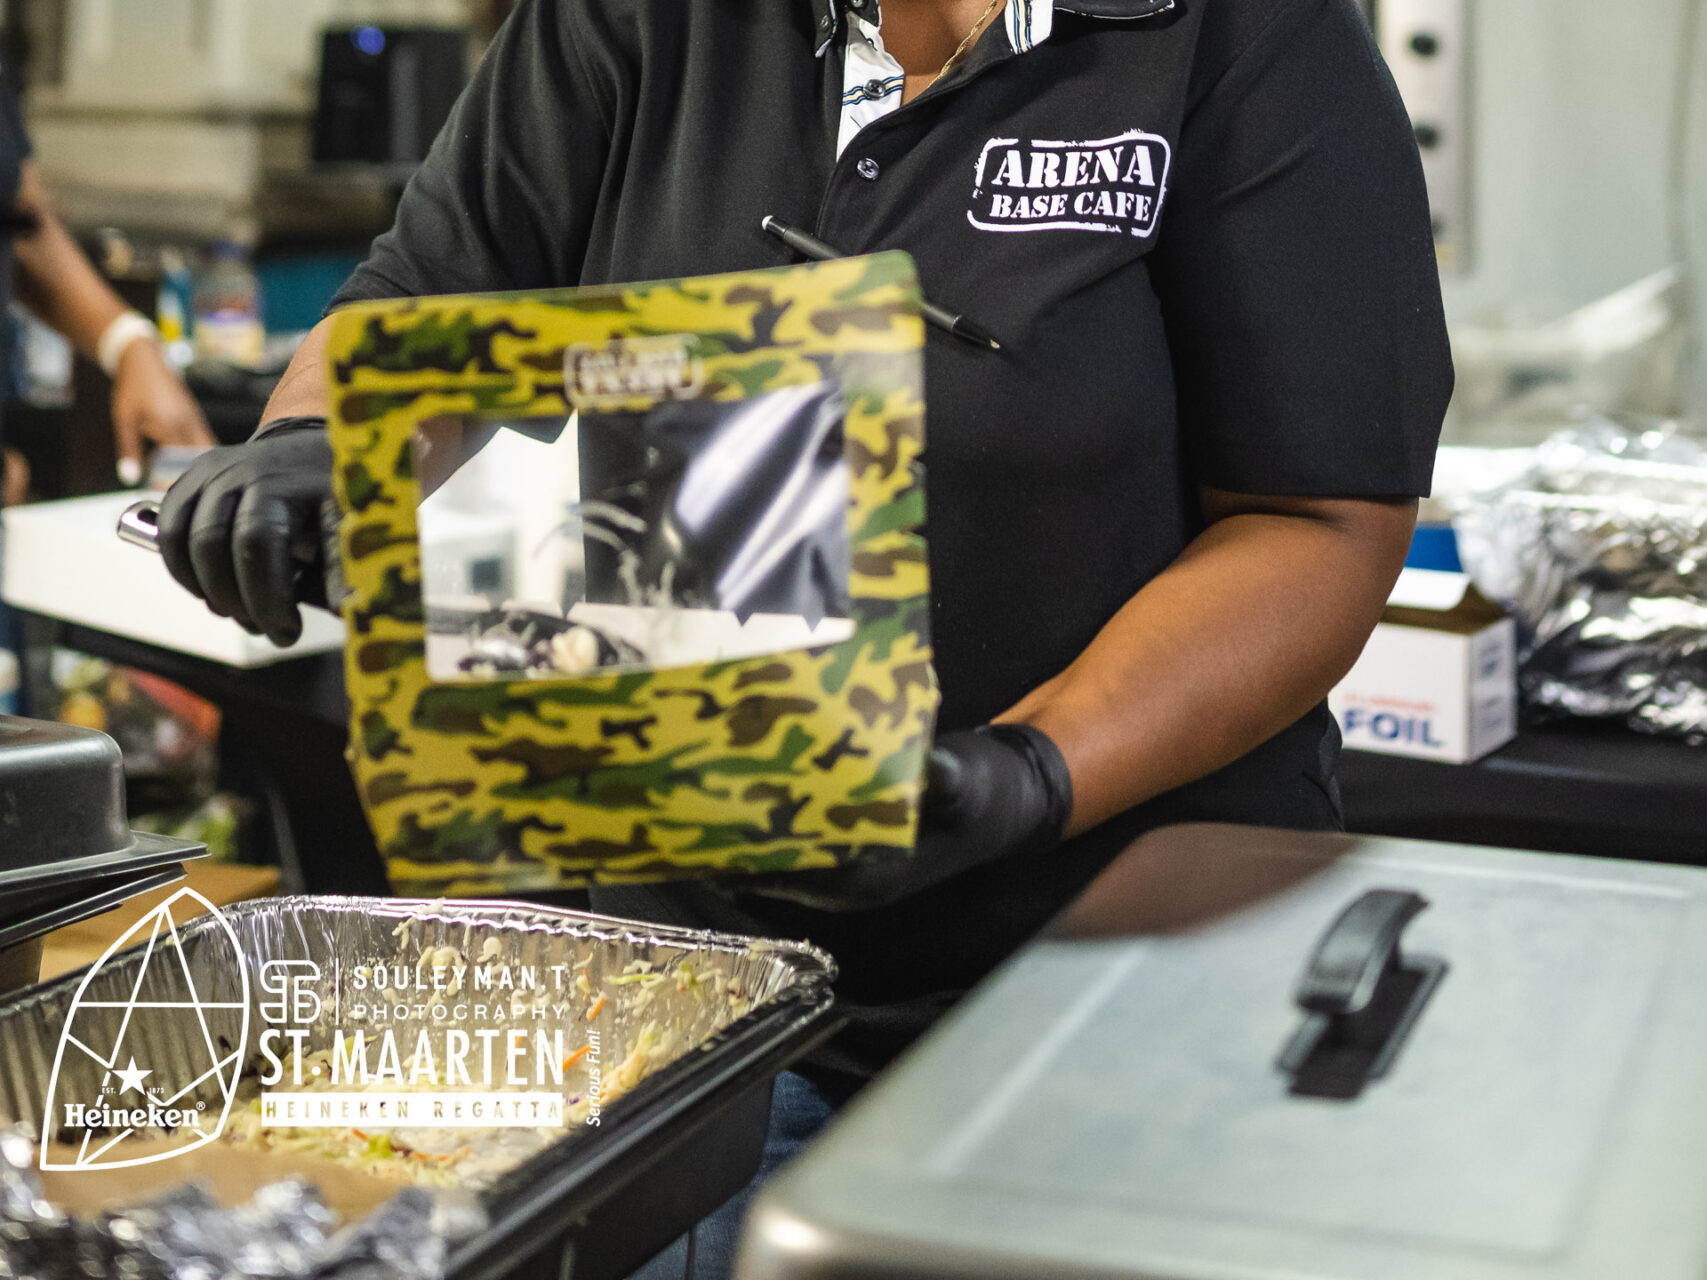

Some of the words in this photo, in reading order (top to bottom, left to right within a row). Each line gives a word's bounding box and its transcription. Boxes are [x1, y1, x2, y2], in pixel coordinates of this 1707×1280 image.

[991, 145, 1156, 188] ARENA
[989, 194, 1069, 218] BASE
[1074, 191, 1152, 221] CAFE
[1341, 710, 1441, 746] FOIL
